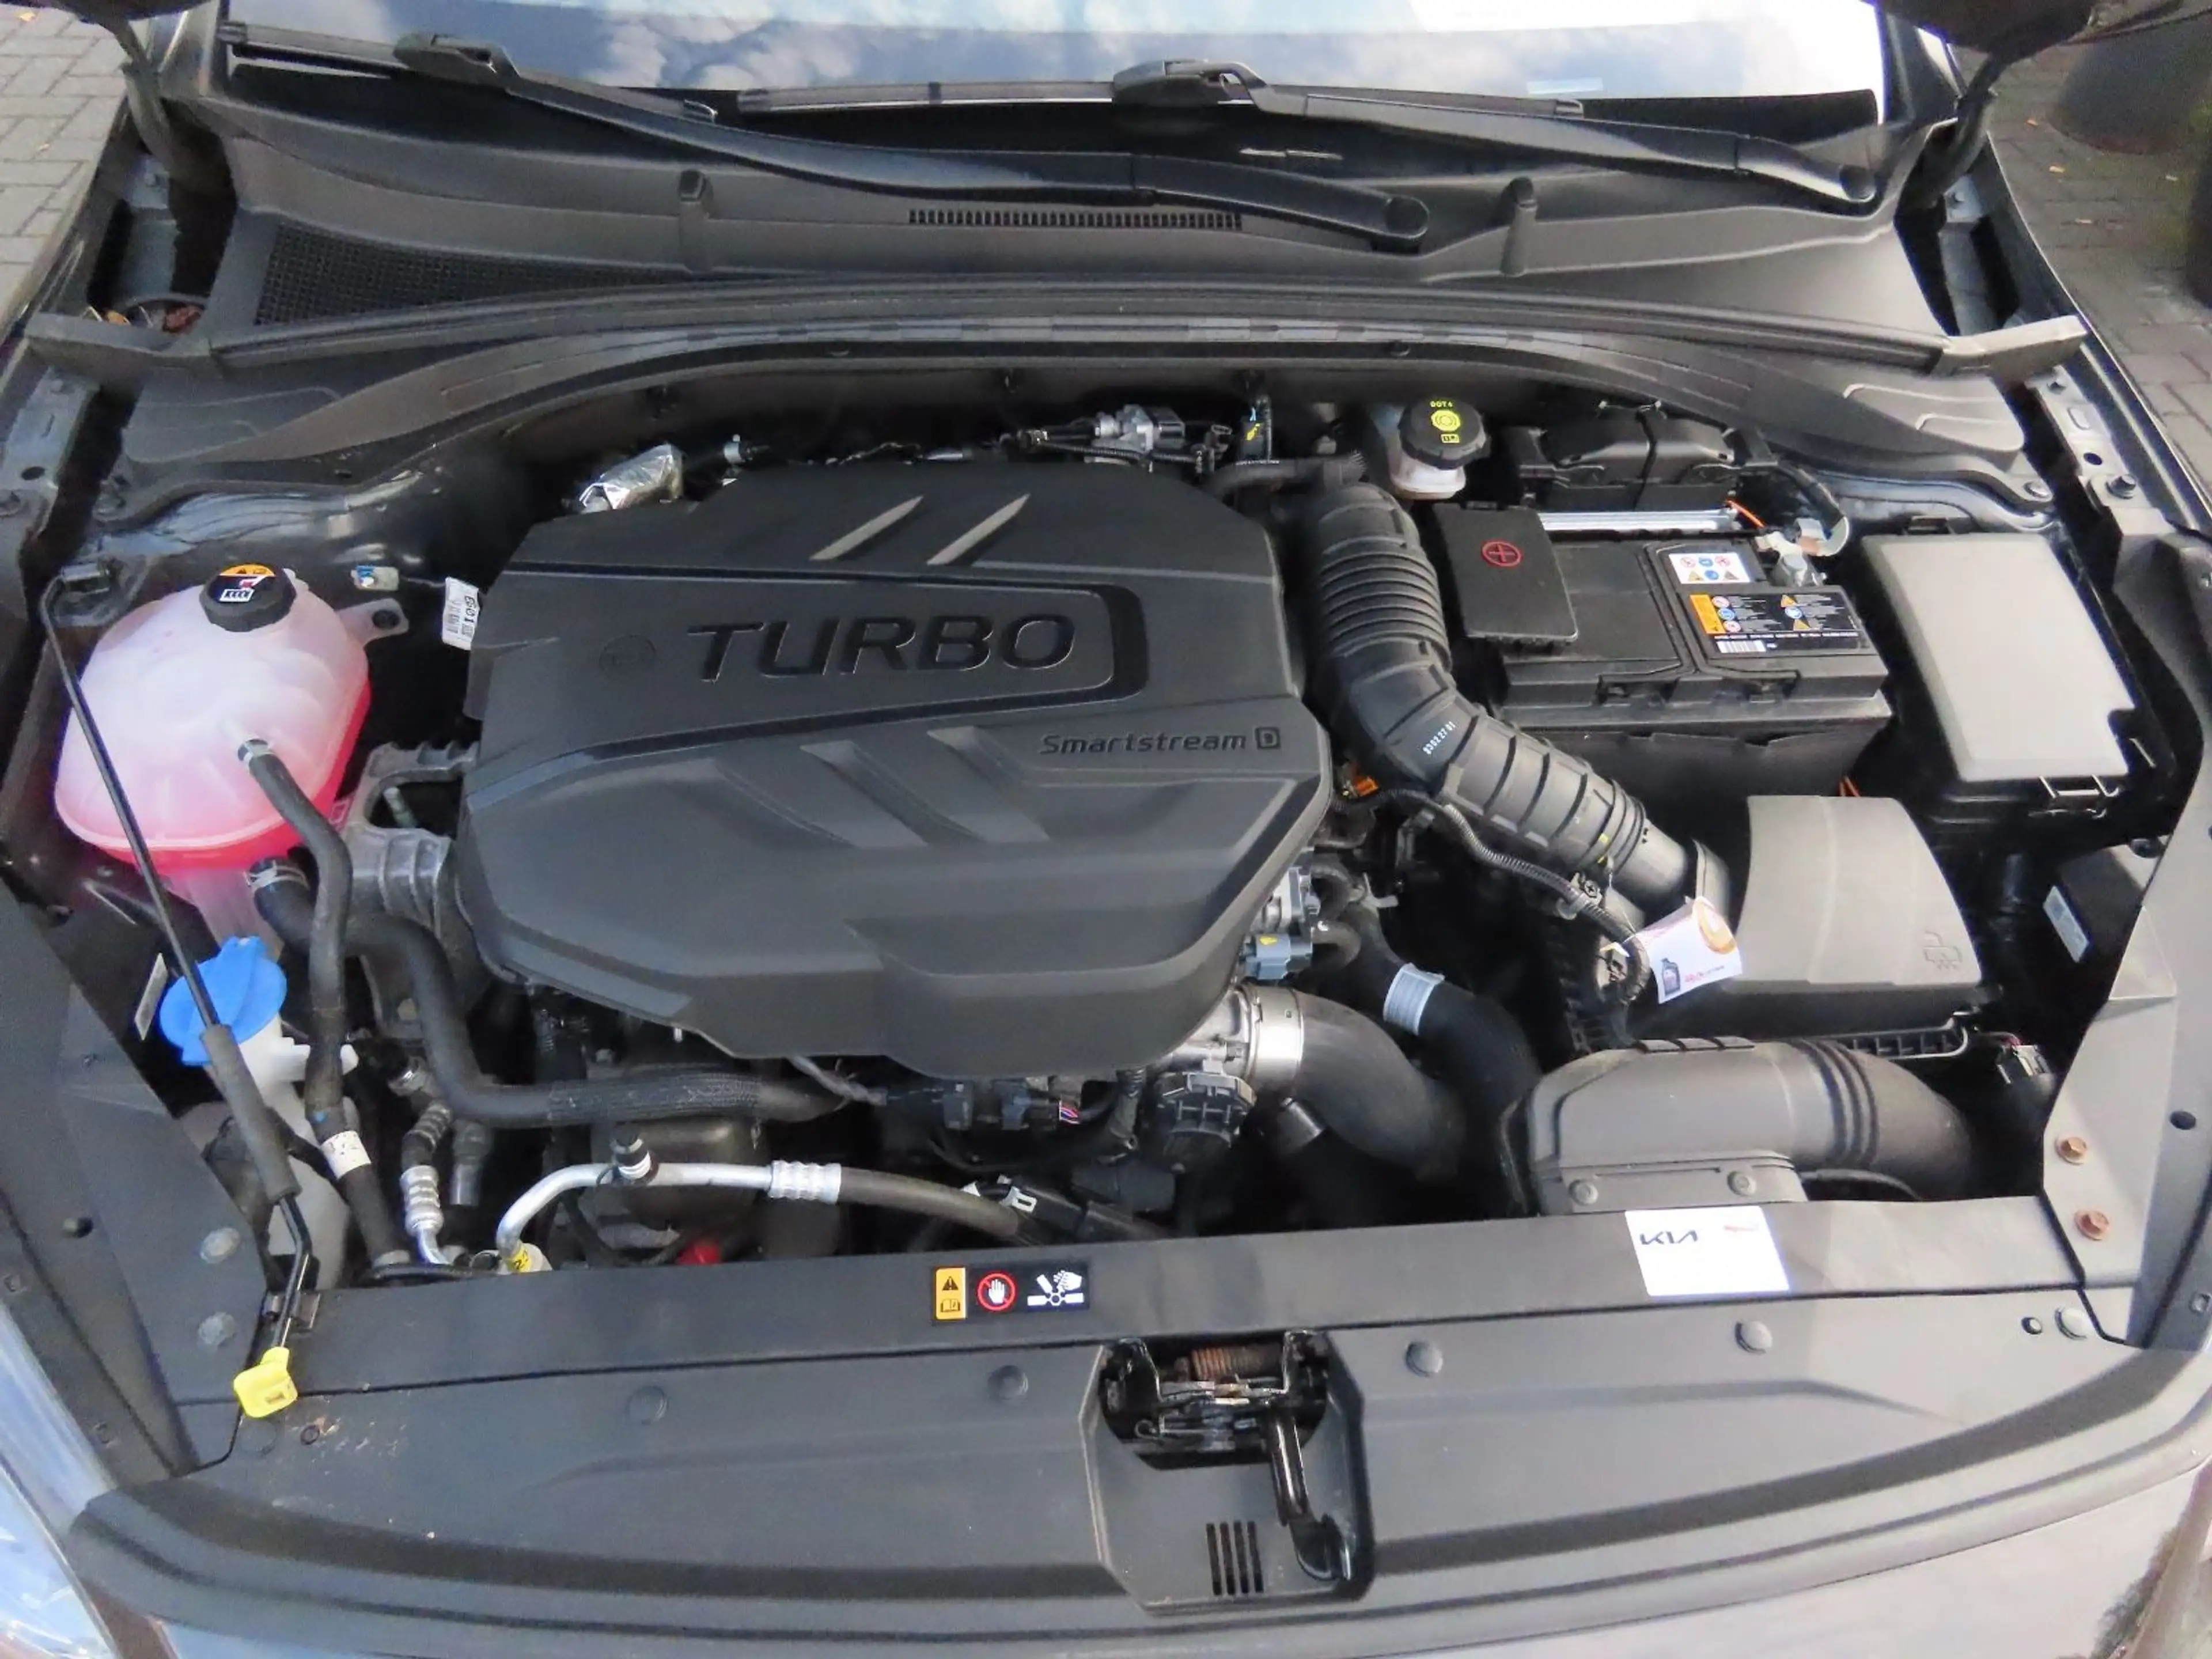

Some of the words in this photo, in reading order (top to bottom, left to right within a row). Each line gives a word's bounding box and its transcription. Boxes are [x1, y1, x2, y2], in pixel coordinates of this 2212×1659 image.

[688, 613, 1076, 684] TURBO
[1040, 730, 1247, 755] Smartstream
[1639, 1230, 1699, 1245] KIA
